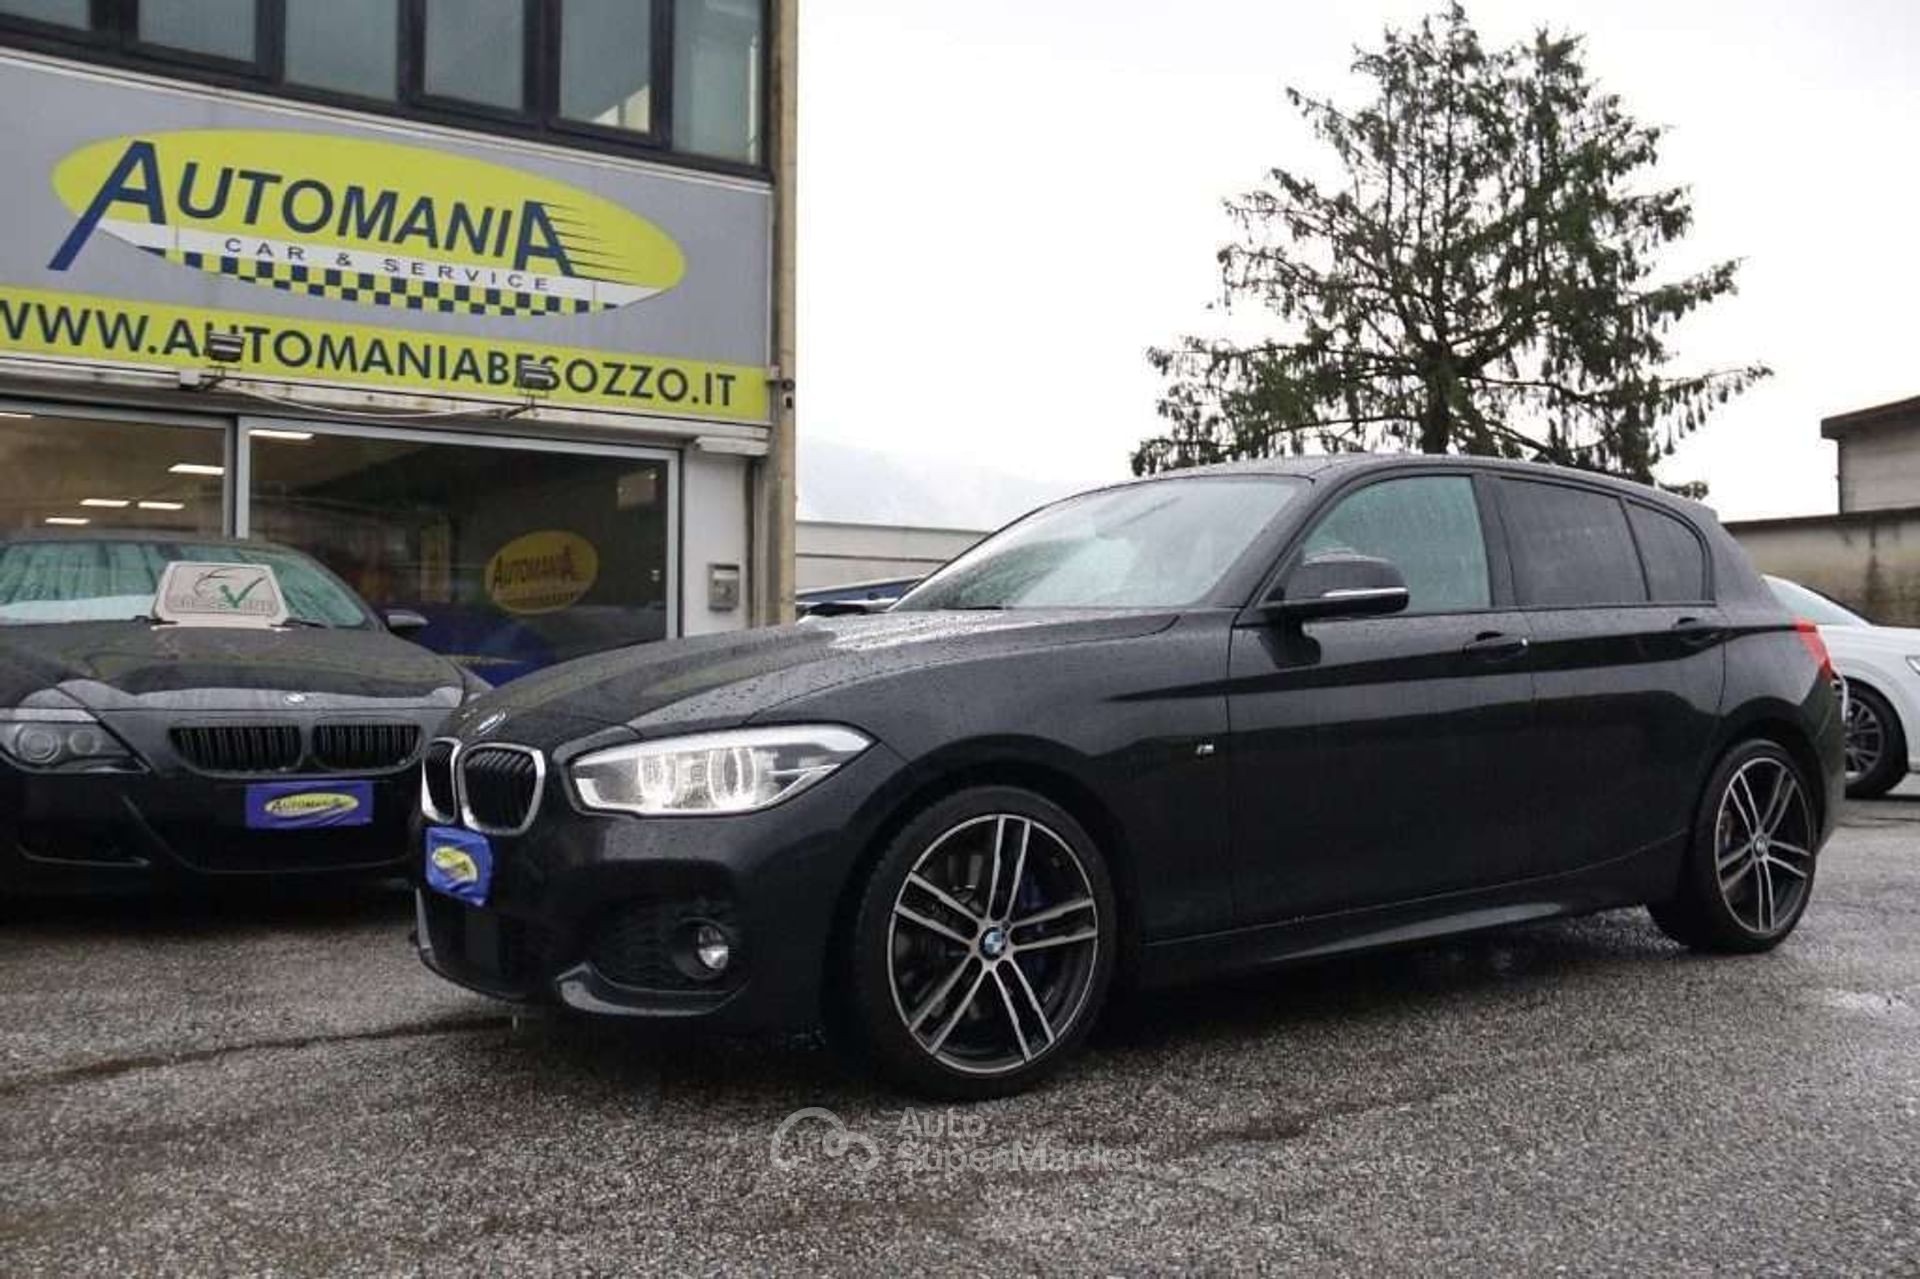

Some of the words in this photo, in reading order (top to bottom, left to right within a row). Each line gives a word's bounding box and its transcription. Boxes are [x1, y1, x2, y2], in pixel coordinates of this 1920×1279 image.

[47, 139, 575, 278] AUTOMANIA
[224, 238, 305, 261] CAR
[336, 252, 352, 267] &
[384, 257, 549, 291] SERVICE
